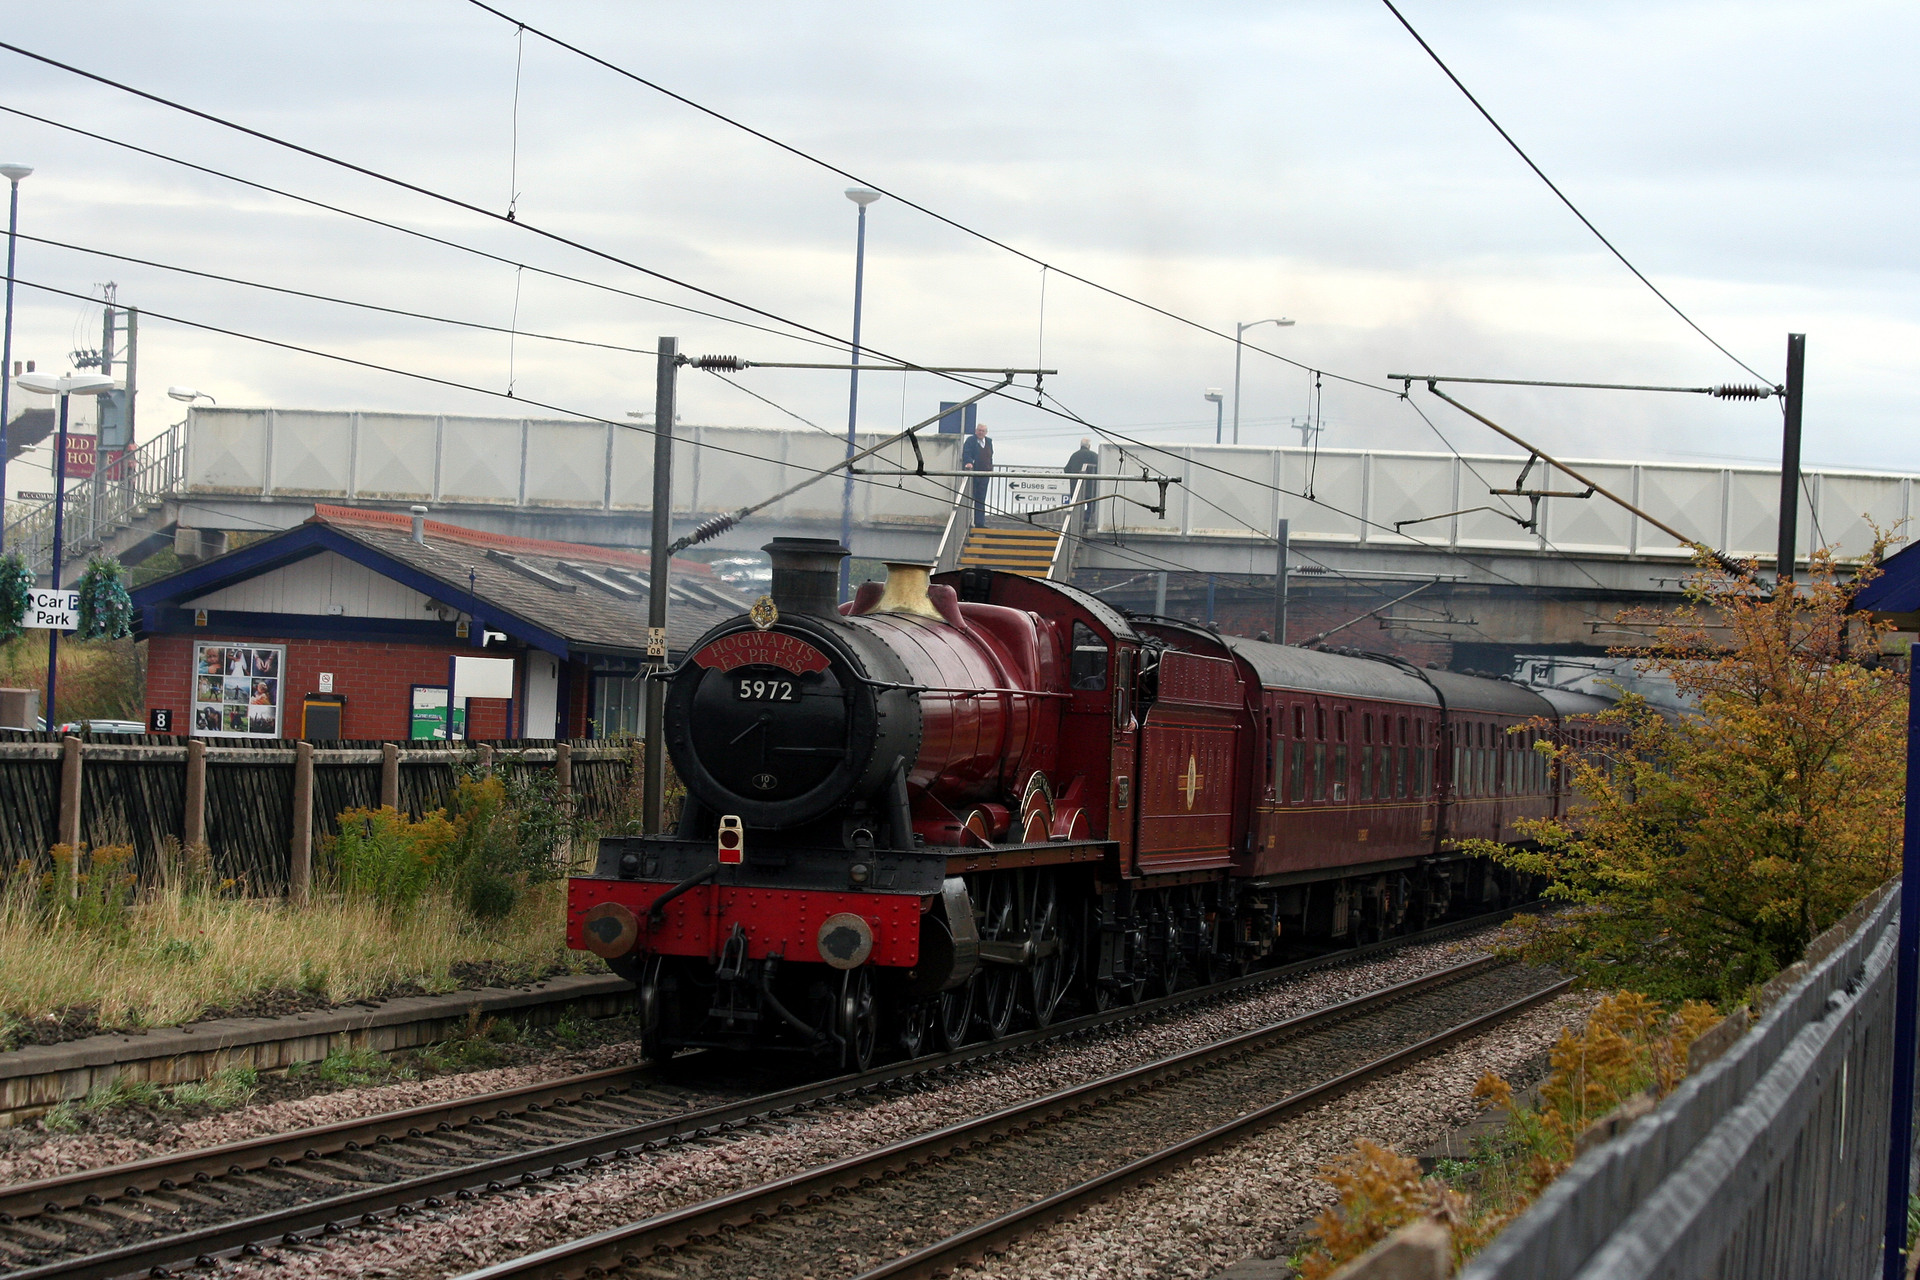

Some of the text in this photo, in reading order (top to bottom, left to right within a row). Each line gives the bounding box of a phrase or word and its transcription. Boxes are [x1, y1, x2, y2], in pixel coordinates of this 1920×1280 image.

[67, 451, 114, 466] HOUE
[1062, 496, 1069, 504] P
[37, 594, 80, 609] Car P
[36, 610, 70, 626] Park
[649, 637, 664, 646] 339
[709, 632, 816, 662] HOGWARTS
[650, 647, 661, 655] 08
[719, 648, 805, 675] EXPRESS
[739, 679, 793, 701] 5972
[157, 713, 165, 727] 8
[761, 775, 770, 783] 10
